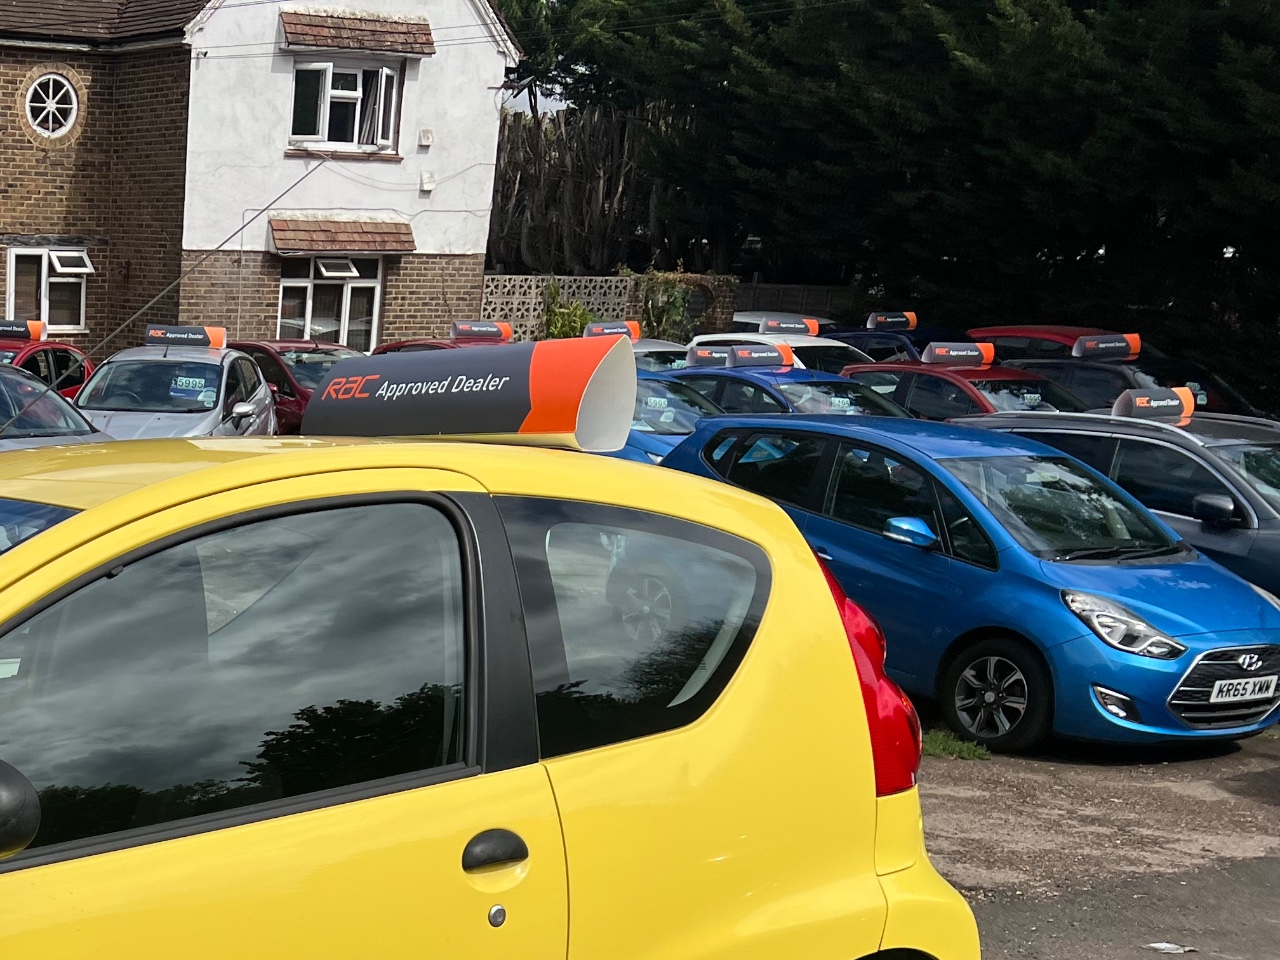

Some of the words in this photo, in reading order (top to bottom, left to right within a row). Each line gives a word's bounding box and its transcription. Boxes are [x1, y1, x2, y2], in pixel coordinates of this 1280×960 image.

[166, 332, 188, 340] Approved
[375, 375, 452, 401] Approved
[451, 373, 510, 393] Dealer
[1216, 682, 1250, 698] KR65
